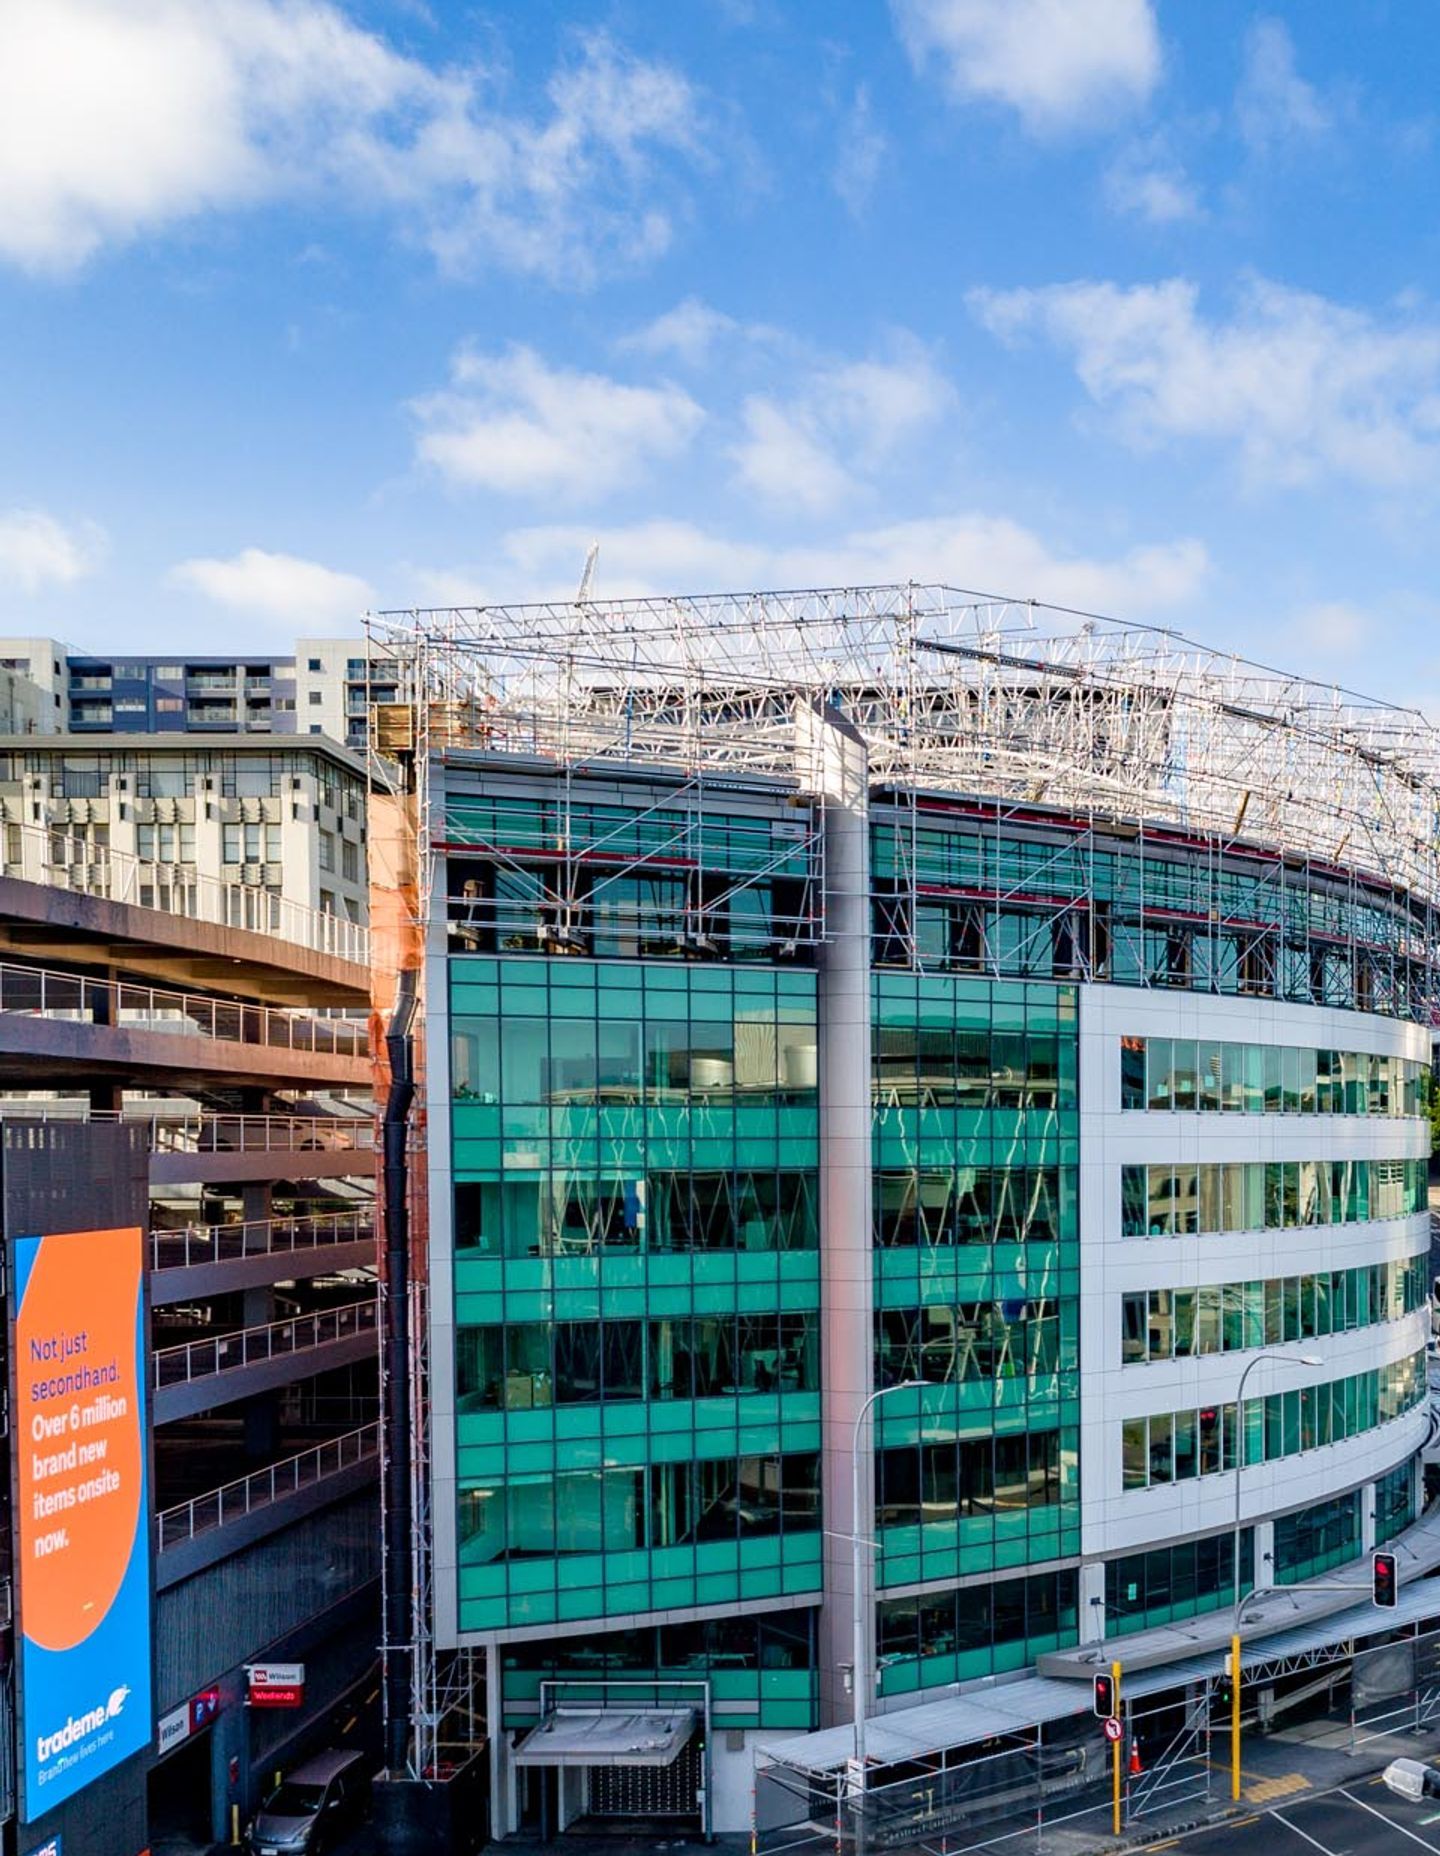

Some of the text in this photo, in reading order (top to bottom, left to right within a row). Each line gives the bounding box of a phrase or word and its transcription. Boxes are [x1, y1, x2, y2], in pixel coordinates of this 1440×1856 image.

[31, 1332, 87, 1362] Not just
[31, 1358, 120, 1401] secondhand.
[31, 1394, 127, 1441] Over 6 million
[32, 1438, 108, 1481] brand new
[33, 1467, 120, 1520] items onsite
[34, 1528, 70, 1558] now.
[37, 1705, 105, 1763] trademe
[80, 1741, 97, 1760] lives
[97, 1729, 114, 1748] here
